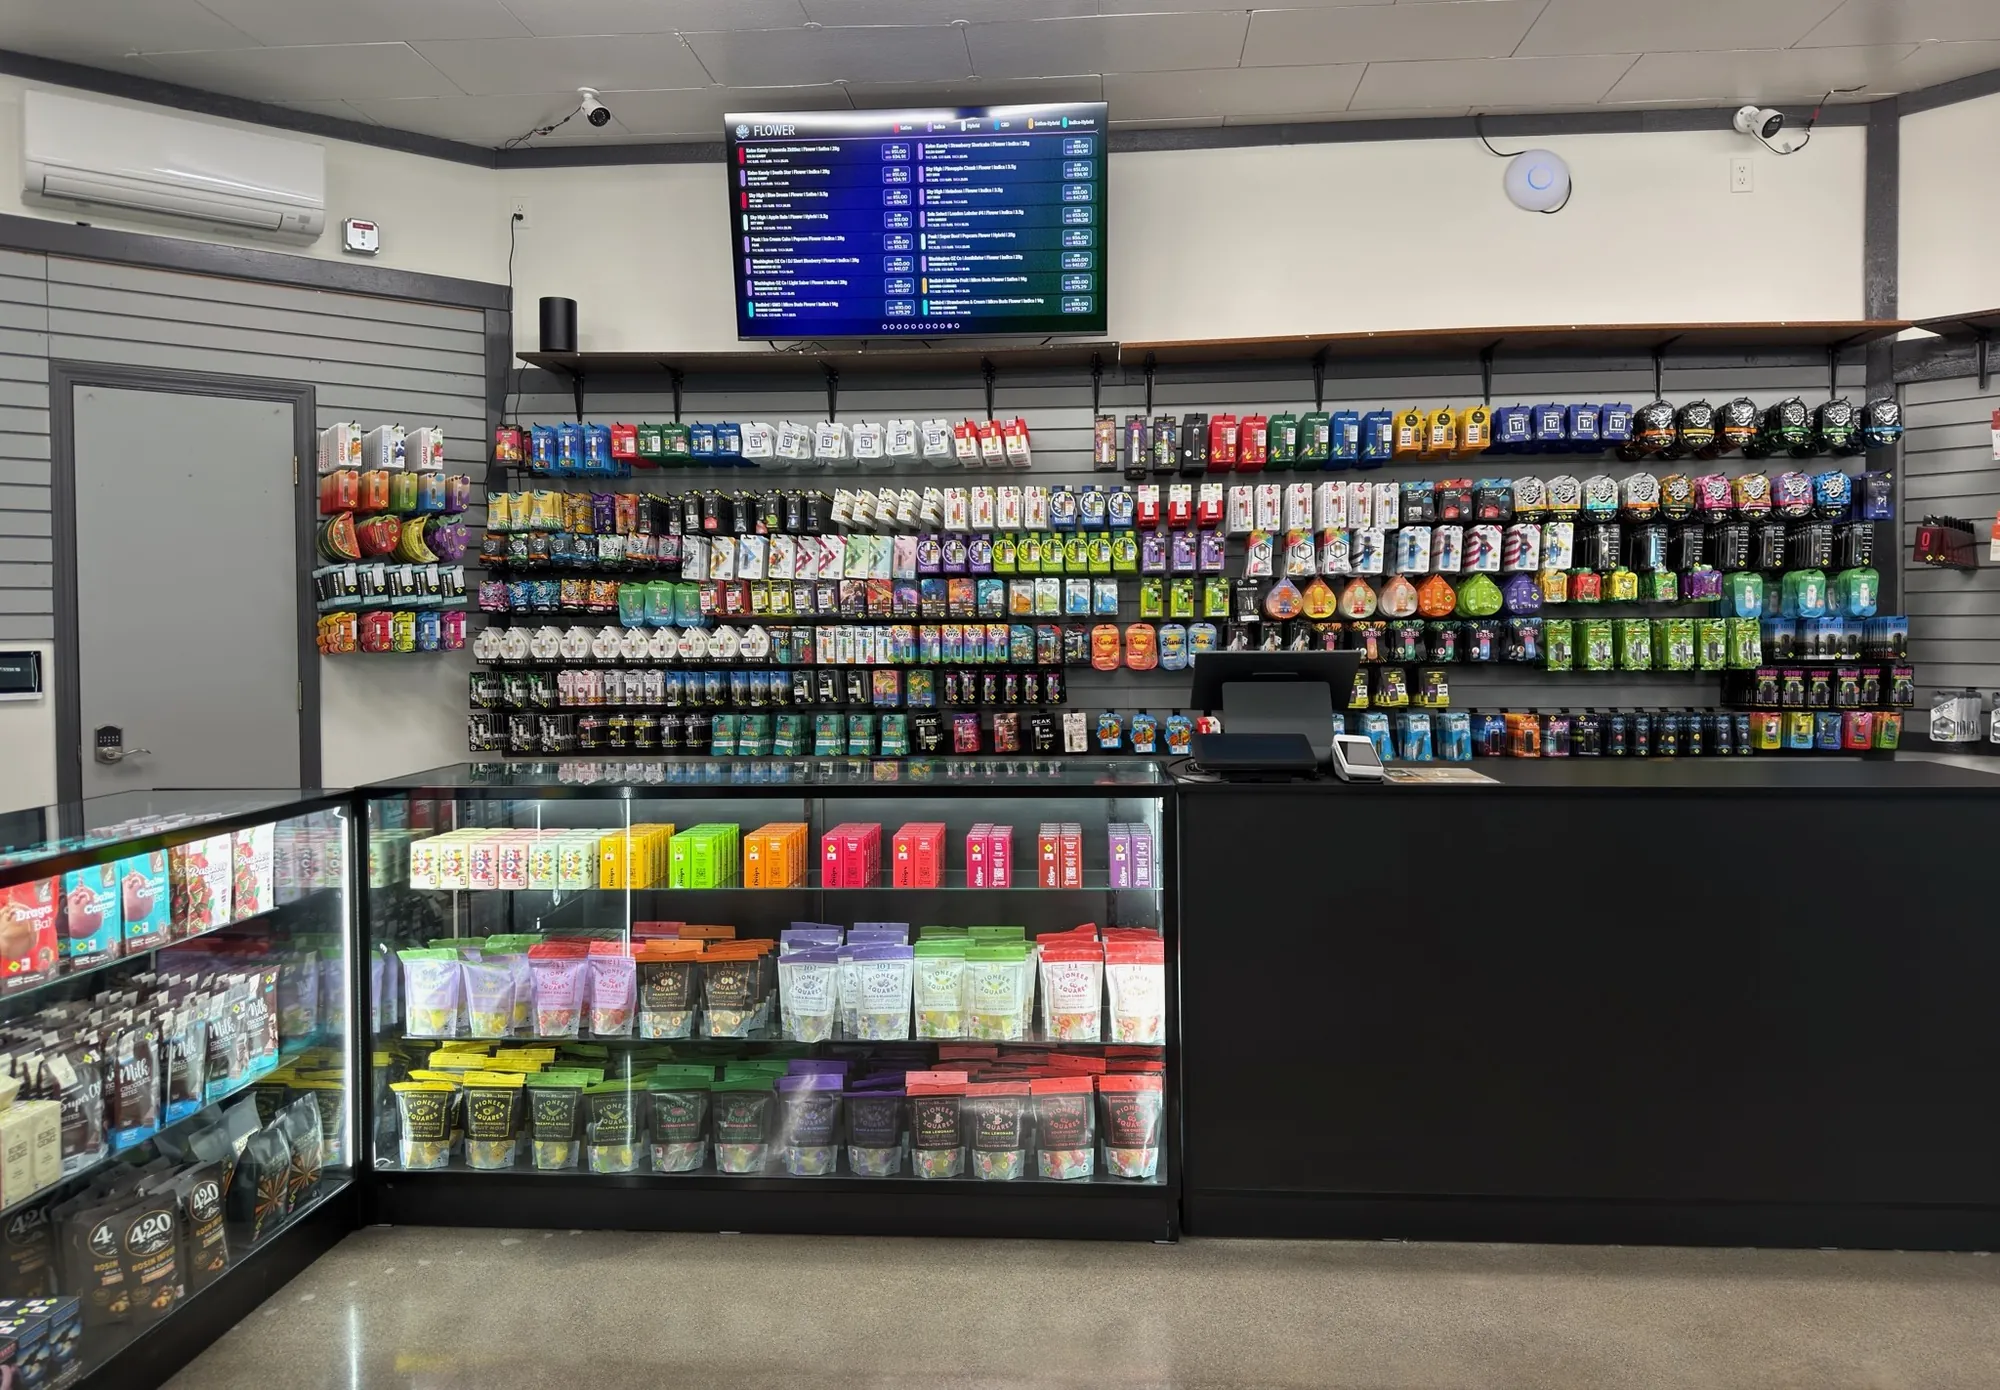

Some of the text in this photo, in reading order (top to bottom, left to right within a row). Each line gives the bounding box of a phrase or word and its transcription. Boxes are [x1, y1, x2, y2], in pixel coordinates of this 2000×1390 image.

[754, 124, 796, 136] FLOWER
[1512, 421, 1522, 430] Tr
[1548, 419, 1557, 428] Tr
[1582, 418, 1591, 428] Tr
[1614, 418, 1623, 428] Tr
[651, 970, 683, 981] PIONEER
[867, 972, 899, 983] PIONEER
[1058, 972, 1089, 983] PIONEER
[651, 983, 681, 993] SQUARES
[712, 981, 741, 991] SQUARES
[867, 984, 898, 995] SQUARES
[248, 998, 268, 1016] Milk
[209, 1017, 235, 1038] Milk
[120, 1058, 151, 1082] Milk
[408, 1099, 439, 1109] PIONEER
[474, 1099, 505, 1109] PIONEER
[408, 1111, 438, 1122] SQUARES
[473, 1111, 505, 1122] SQUARES
[922, 1105, 954, 1117] PIONEER
[981, 1106, 1014, 1118] PIONEER
[922, 1120, 954, 1129] SQUARES
[982, 1120, 1014, 1131] SQUARES
[193, 1183, 219, 1210] 420
[129, 1213, 171, 1244] 420
